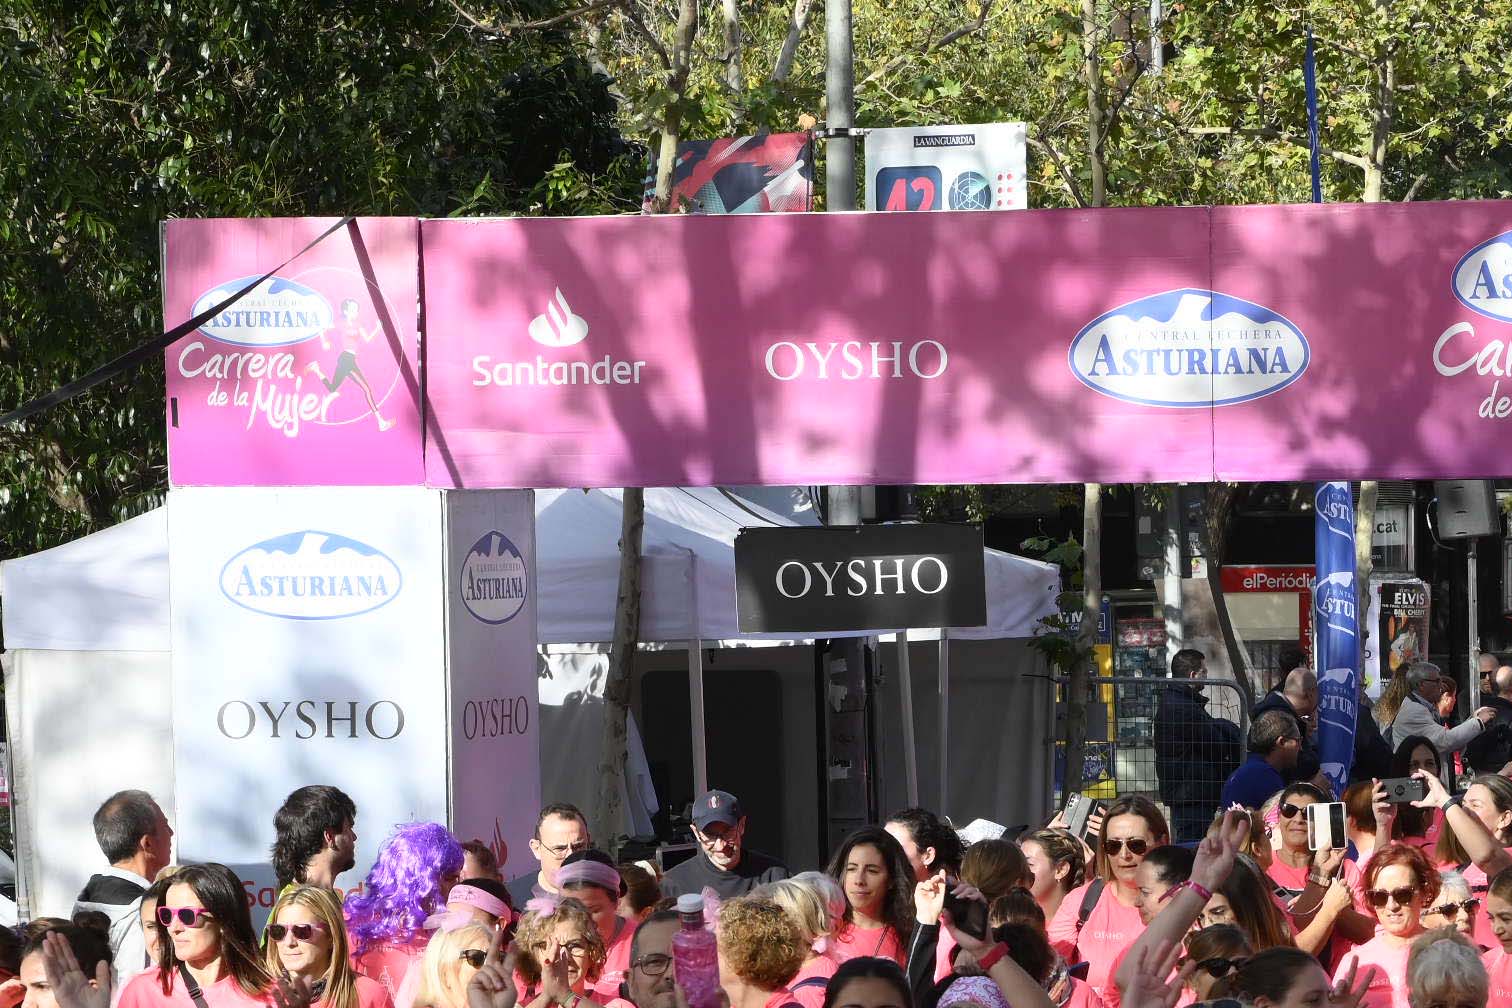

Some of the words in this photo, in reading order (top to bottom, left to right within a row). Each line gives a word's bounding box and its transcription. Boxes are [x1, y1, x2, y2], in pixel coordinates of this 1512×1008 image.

[178, 341, 294, 379] Carrera
[473, 354, 646, 387] Santander
[765, 339, 949, 381] OYSHO
[1088, 334, 1292, 376] ASTURIANA
[207, 381, 229, 407] de
[233, 378, 248, 407] la
[246, 375, 340, 438] Mujer
[1478, 380, 1512, 420] de
[235, 565, 389, 597] ASTURIANA
[465, 566, 524, 601] ASTURIANA
[774, 556, 949, 599] OYSHO
[1394, 591, 1425, 605] ELVIS
[216, 700, 406, 741] OYSHO
[463, 695, 529, 741] OYSHO
